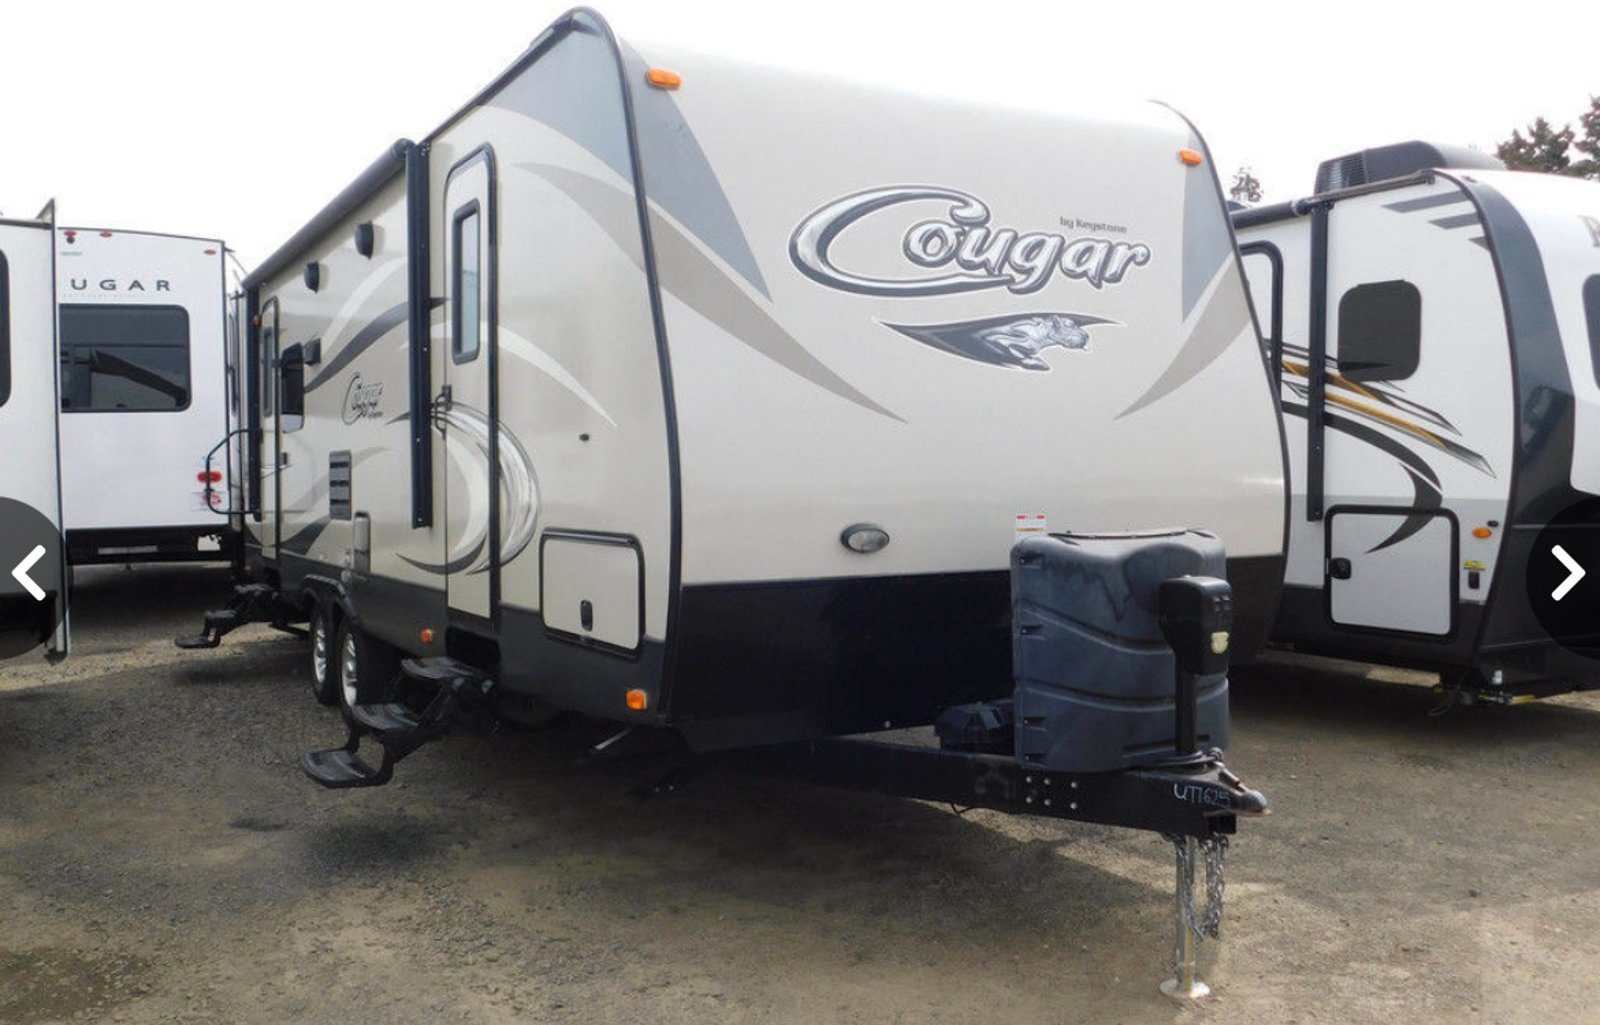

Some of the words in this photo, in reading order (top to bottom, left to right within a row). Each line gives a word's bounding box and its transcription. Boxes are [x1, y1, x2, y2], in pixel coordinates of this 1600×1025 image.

[1059, 215, 1074, 230] by
[1075, 217, 1128, 234] Keystone
[788, 184, 1151, 296] Cougar
[70, 278, 171, 291] UGAR
